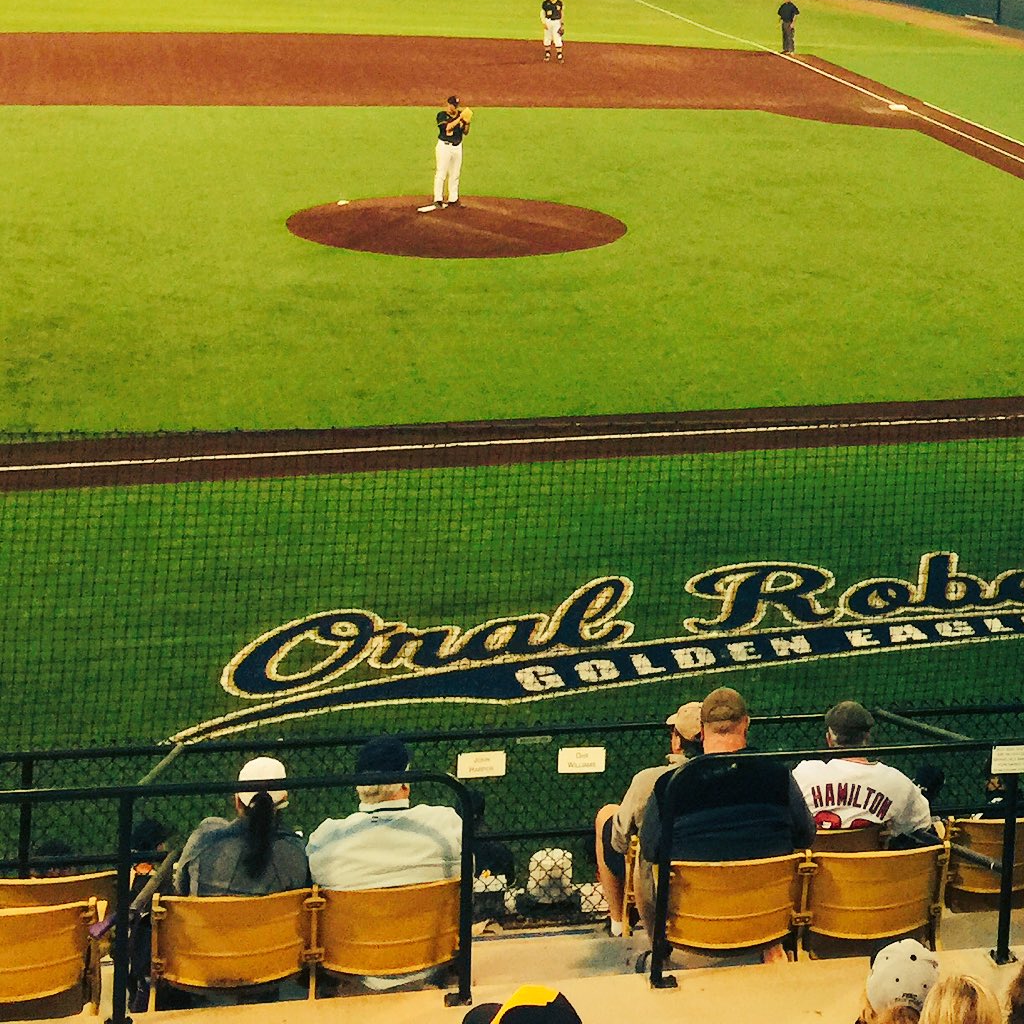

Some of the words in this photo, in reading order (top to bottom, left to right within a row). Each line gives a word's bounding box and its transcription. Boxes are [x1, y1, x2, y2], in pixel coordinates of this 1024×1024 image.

[220, 575, 634, 699] Oral
[515, 634, 808, 692] GOLDEN
[811, 782, 893, 821] HAMILTON
